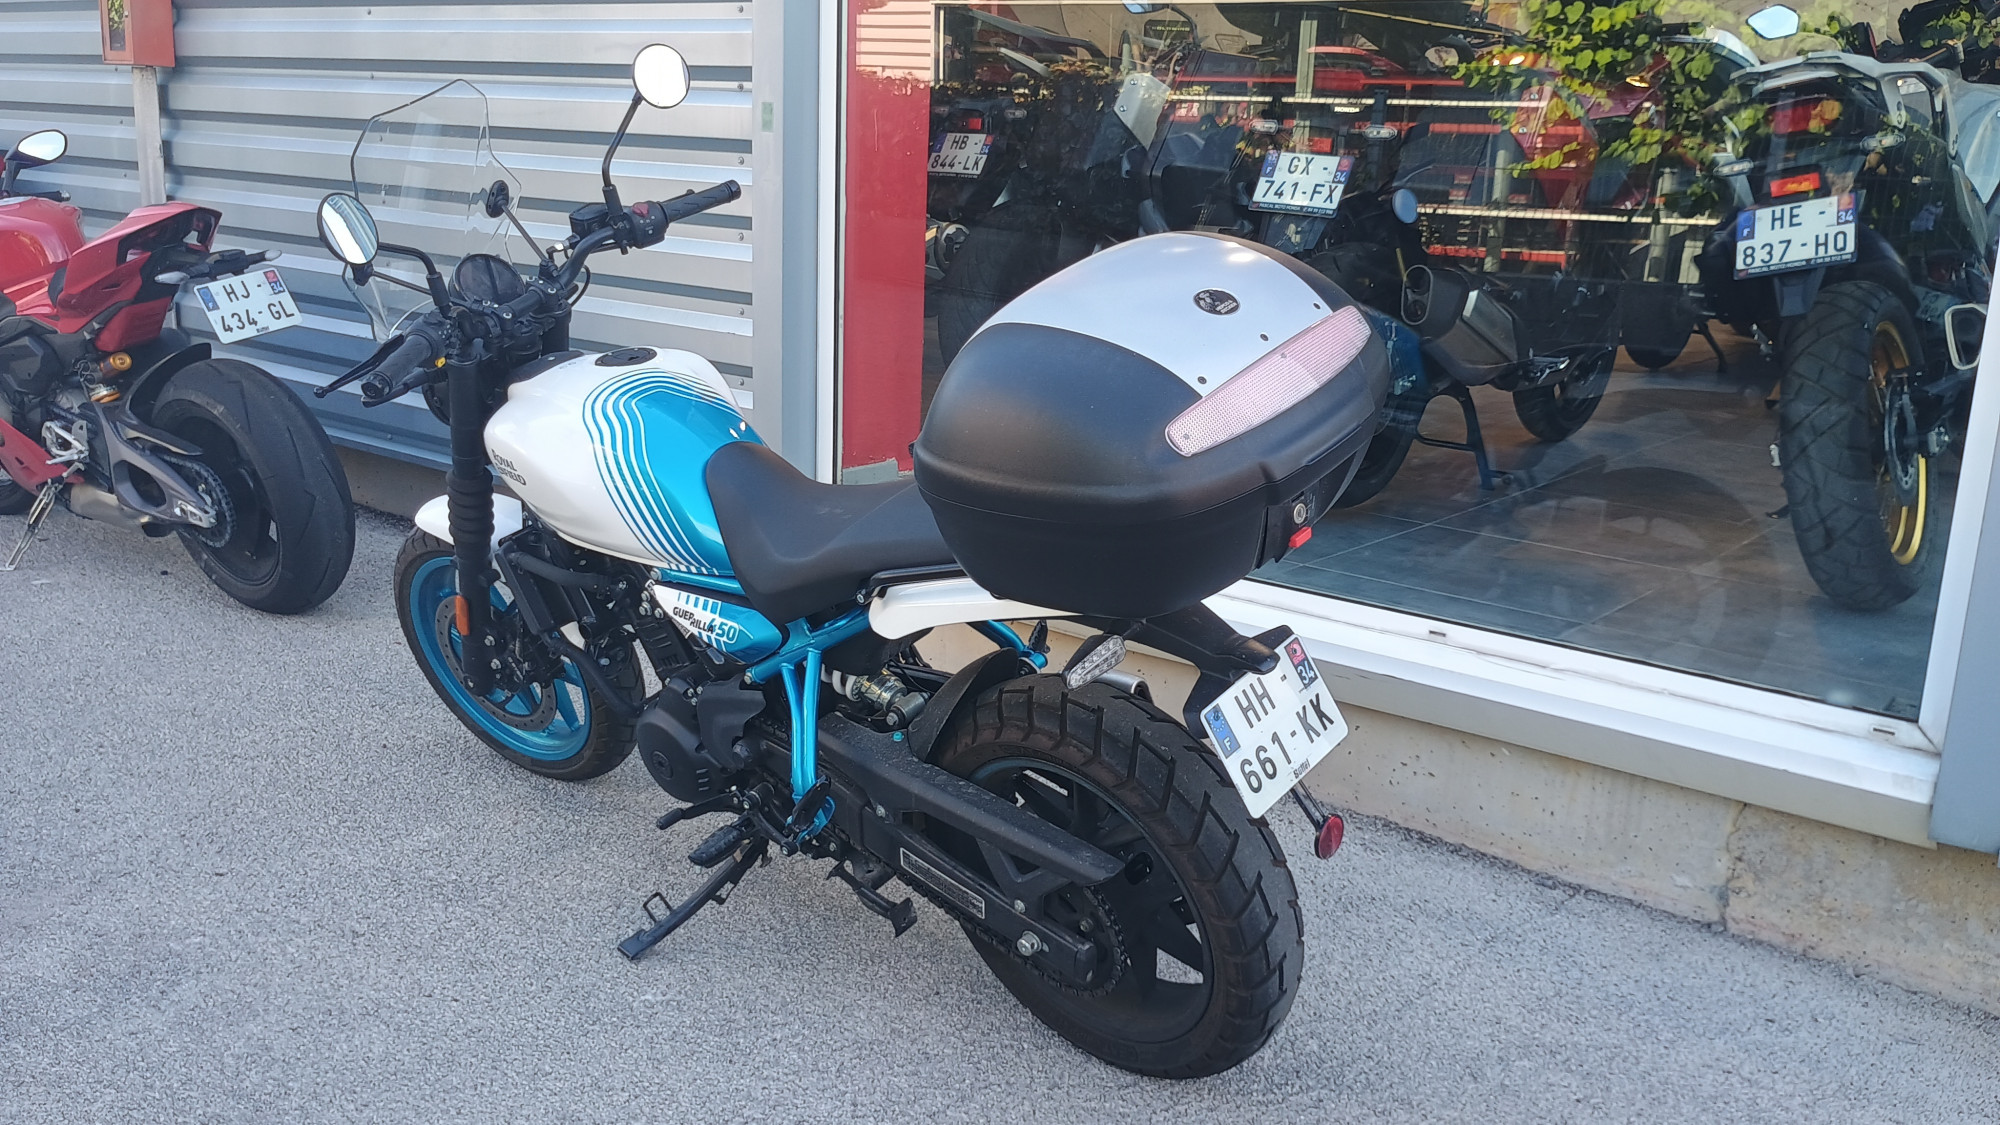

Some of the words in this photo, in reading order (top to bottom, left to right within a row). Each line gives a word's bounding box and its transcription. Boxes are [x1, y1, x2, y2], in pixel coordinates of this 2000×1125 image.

[949, 135, 969, 150] HB
[981, 145, 990, 153] 34
[931, 154, 984, 171] 844-LK
[1287, 156, 1314, 176] GX
[1334, 171, 1346, 182] 34
[1262, 180, 1338, 204] 741-FX
[1770, 205, 1802, 231] HE
[1837, 211, 1854, 222] 34
[222, 280, 250, 303] HJ
[270, 281, 284, 294] 34
[220, 300, 295, 333] 434-GL
[706, 617, 738, 642] 450
[1297, 660, 1315, 684] 34
[1234, 676, 1276, 729] HH
[1223, 736, 1233, 751] F
[1240, 692, 1335, 794] 661-KK
